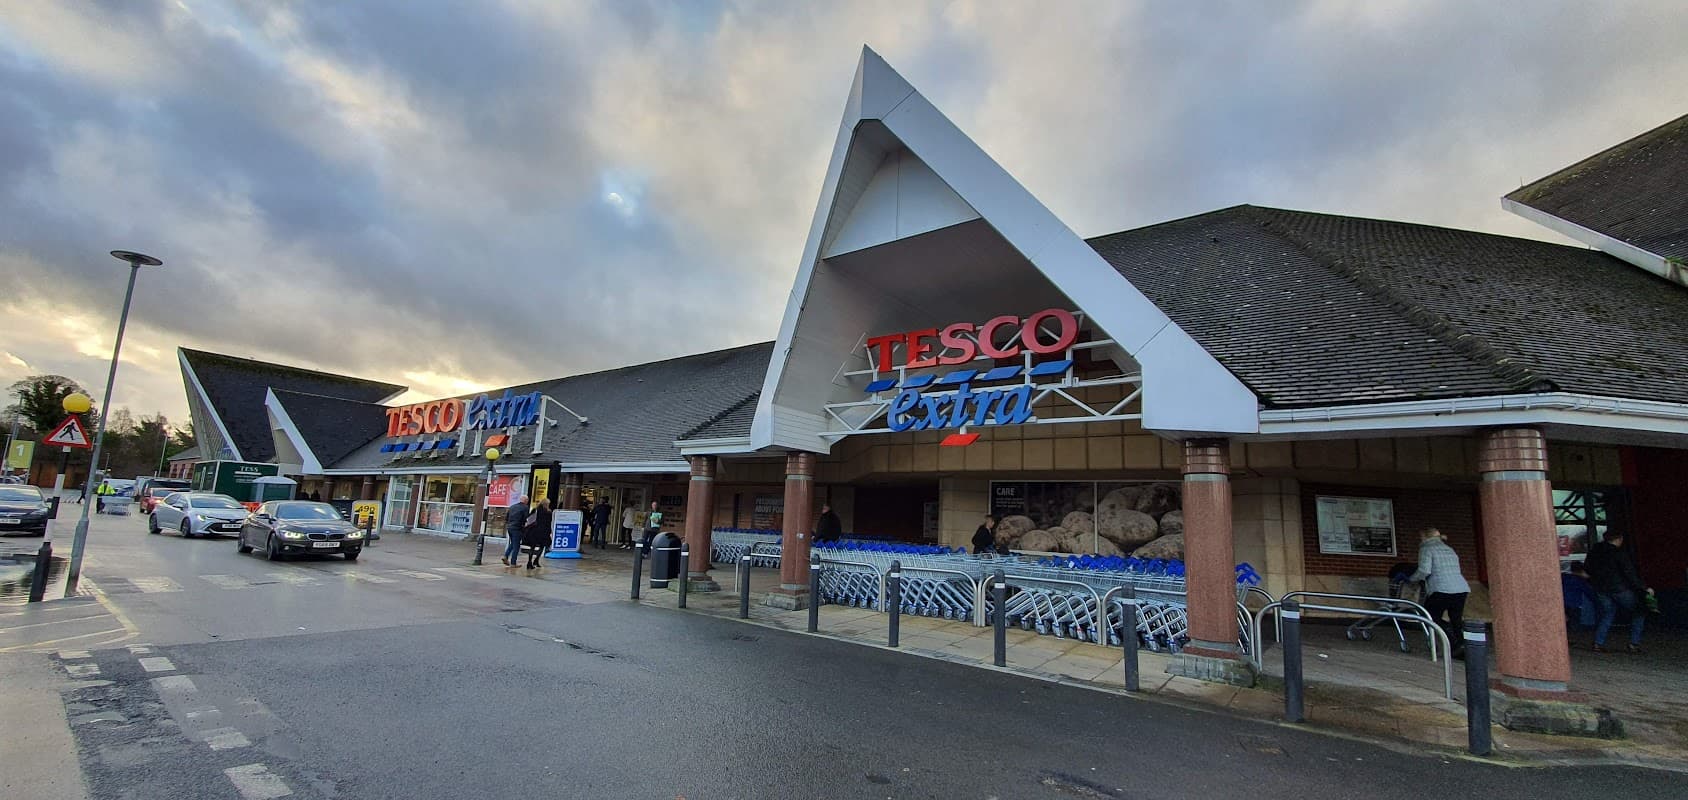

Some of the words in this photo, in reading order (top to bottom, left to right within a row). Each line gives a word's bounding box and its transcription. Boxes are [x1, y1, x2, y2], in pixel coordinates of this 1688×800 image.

[867, 308, 1078, 373] TESCO
[386, 399, 464, 438] TESCO
[468, 390, 542, 430] extra
[886, 382, 1034, 432] extra
[16, 444, 25, 457] 1
[996, 487, 1015, 496] CARE
[554, 536, 569, 548] £8
